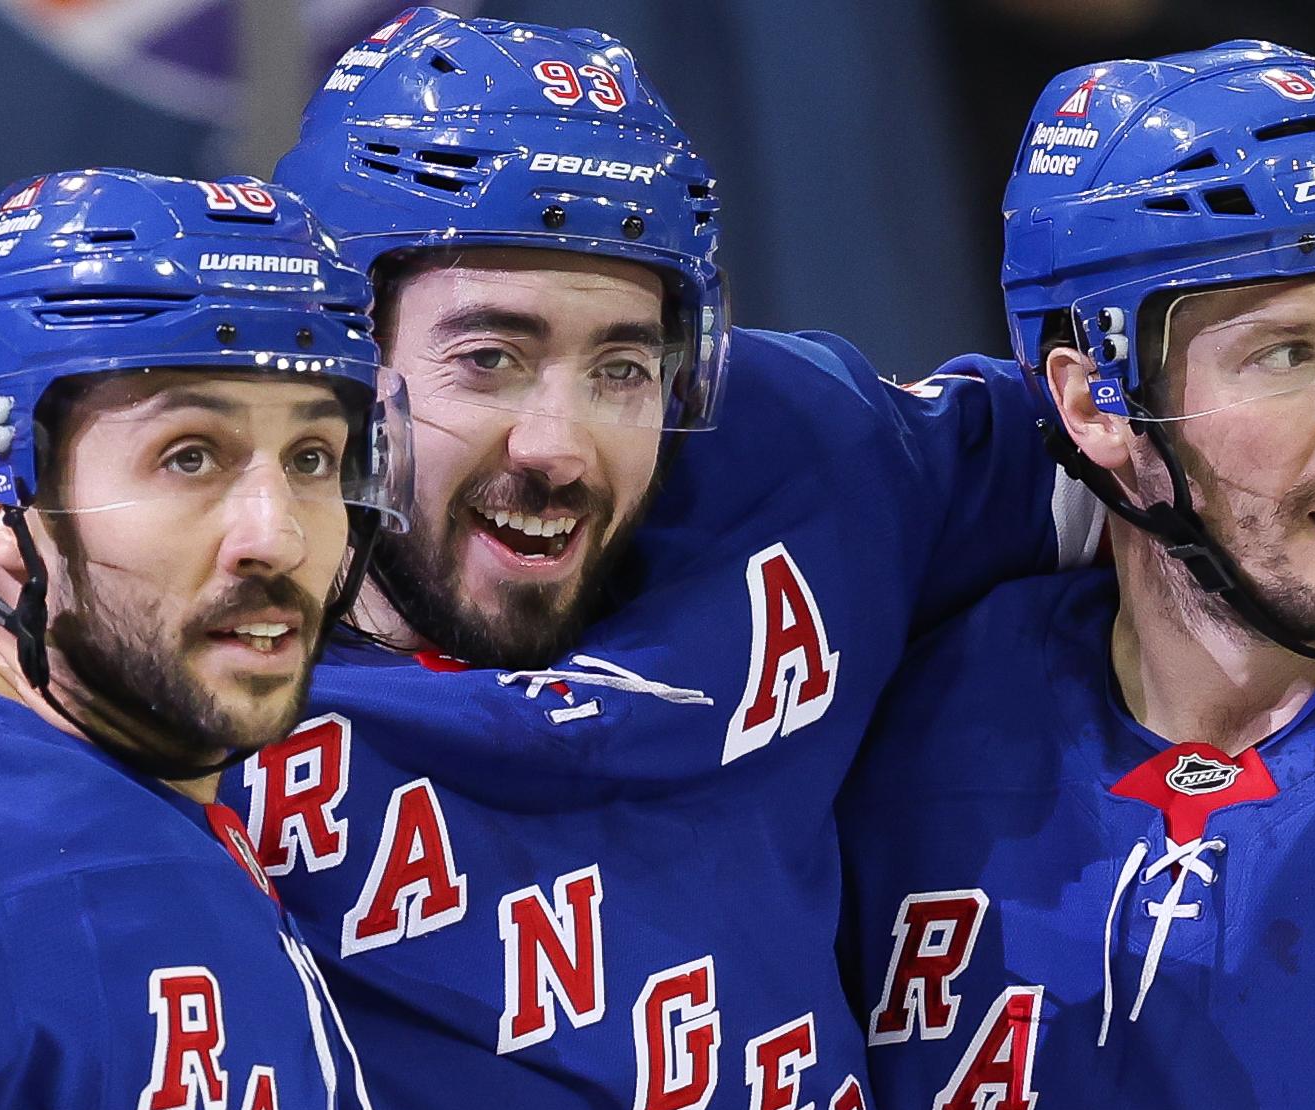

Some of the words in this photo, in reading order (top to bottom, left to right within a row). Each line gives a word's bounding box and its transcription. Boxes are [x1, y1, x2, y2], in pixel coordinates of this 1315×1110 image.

[533, 60, 627, 113] 93
[1030, 120, 1100, 151] Benjamin
[529, 152, 656, 185] BAUER
[1028, 148, 1078, 176] Moore
[199, 253, 320, 276] WARRIOR
[721, 542, 840, 765] A
[1181, 770, 1227, 786] NHL
